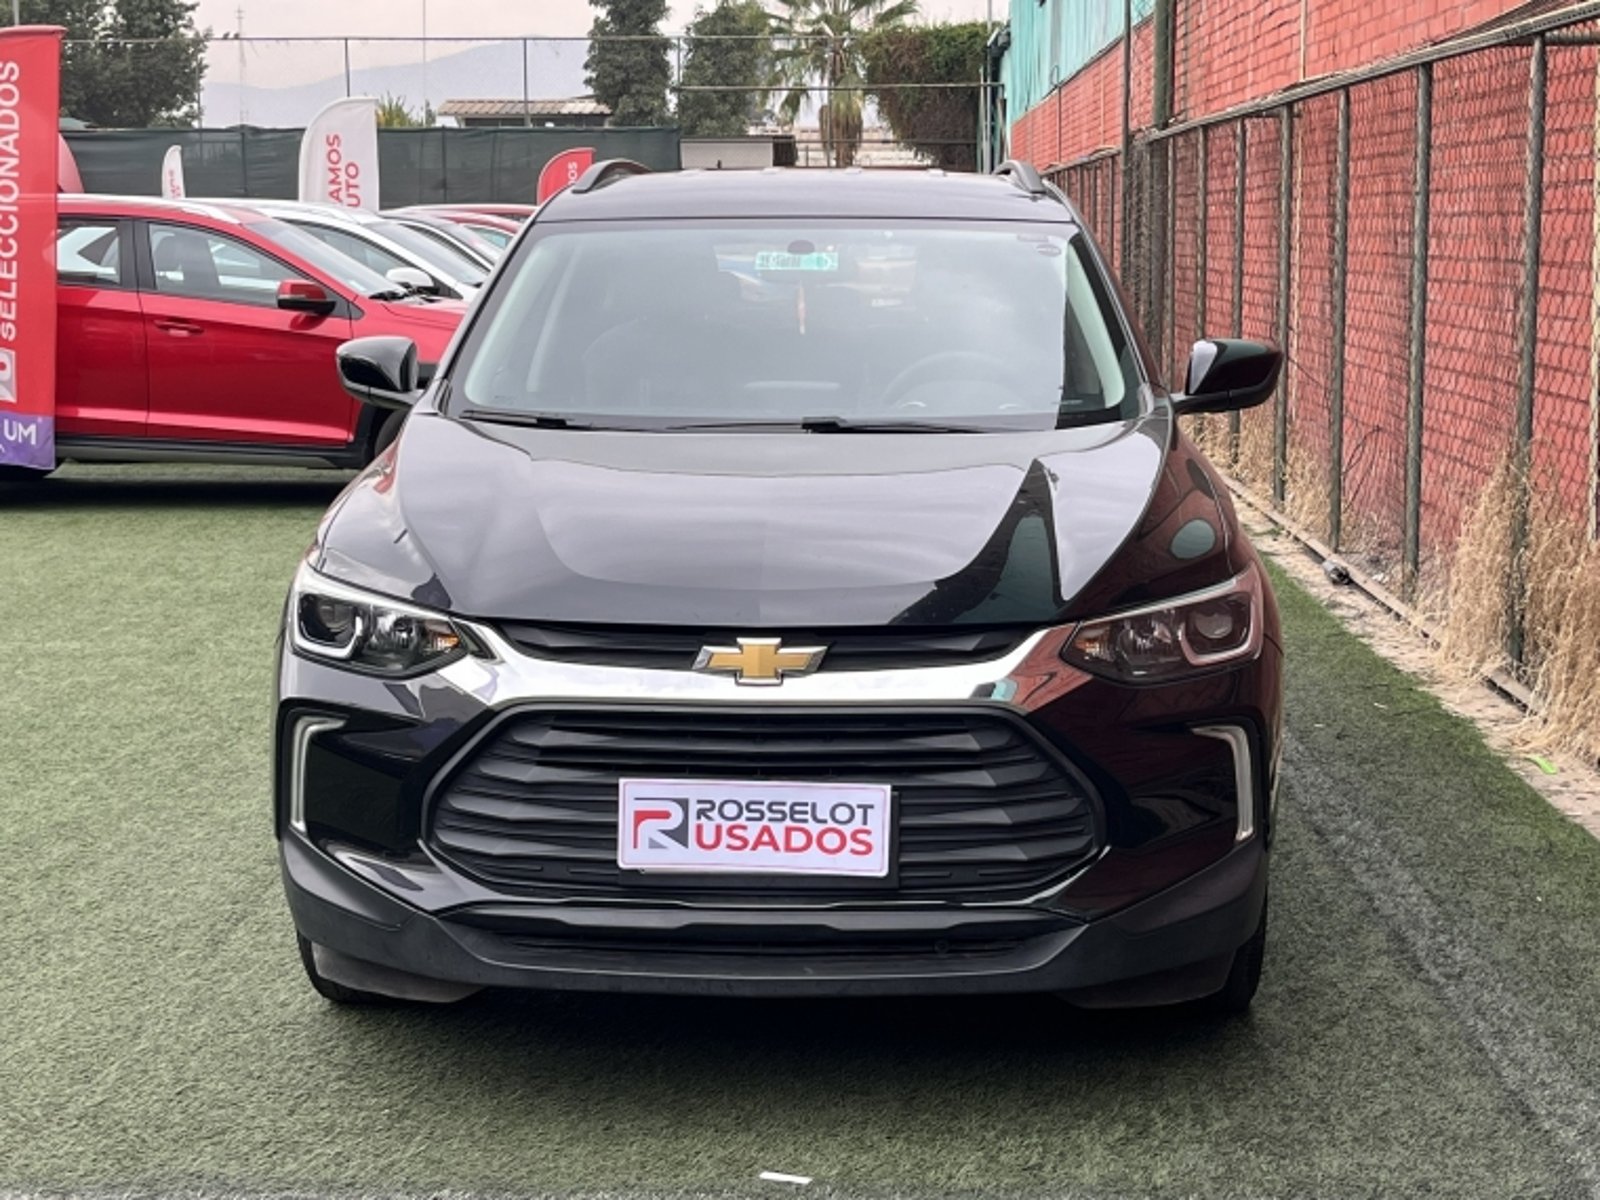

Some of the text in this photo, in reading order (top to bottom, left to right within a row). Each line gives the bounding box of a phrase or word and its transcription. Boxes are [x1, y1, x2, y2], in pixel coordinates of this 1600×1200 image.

[0, 61, 20, 342] SELECCIONADOS
[695, 799, 875, 825] ROSSELOT
[695, 823, 874, 856] USADOS
